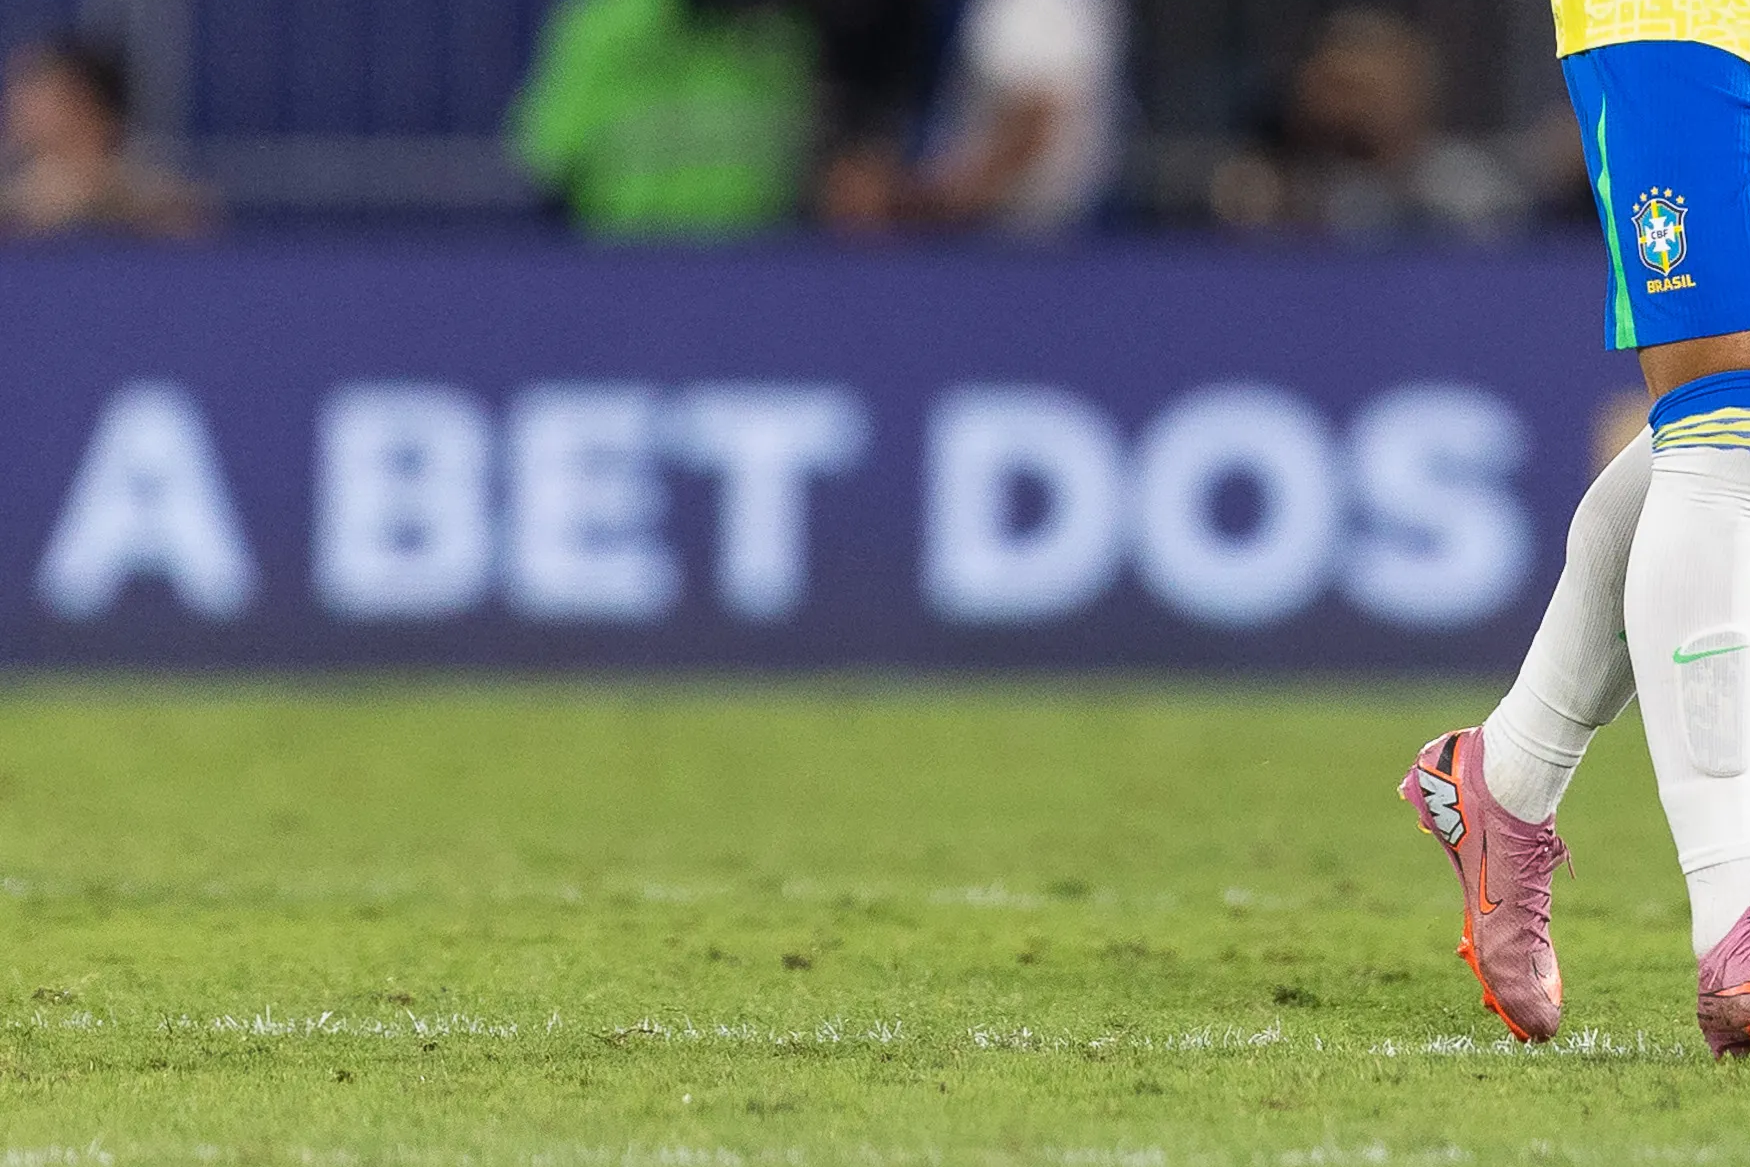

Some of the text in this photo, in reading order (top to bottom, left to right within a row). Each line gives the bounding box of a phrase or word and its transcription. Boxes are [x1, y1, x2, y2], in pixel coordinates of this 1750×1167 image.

[1651, 229, 1668, 239] CBF
[1647, 274, 1696, 293] BRASIL
[36, 382, 258, 618] A
[315, 382, 868, 620] BET
[922, 384, 1530, 626] DOS
